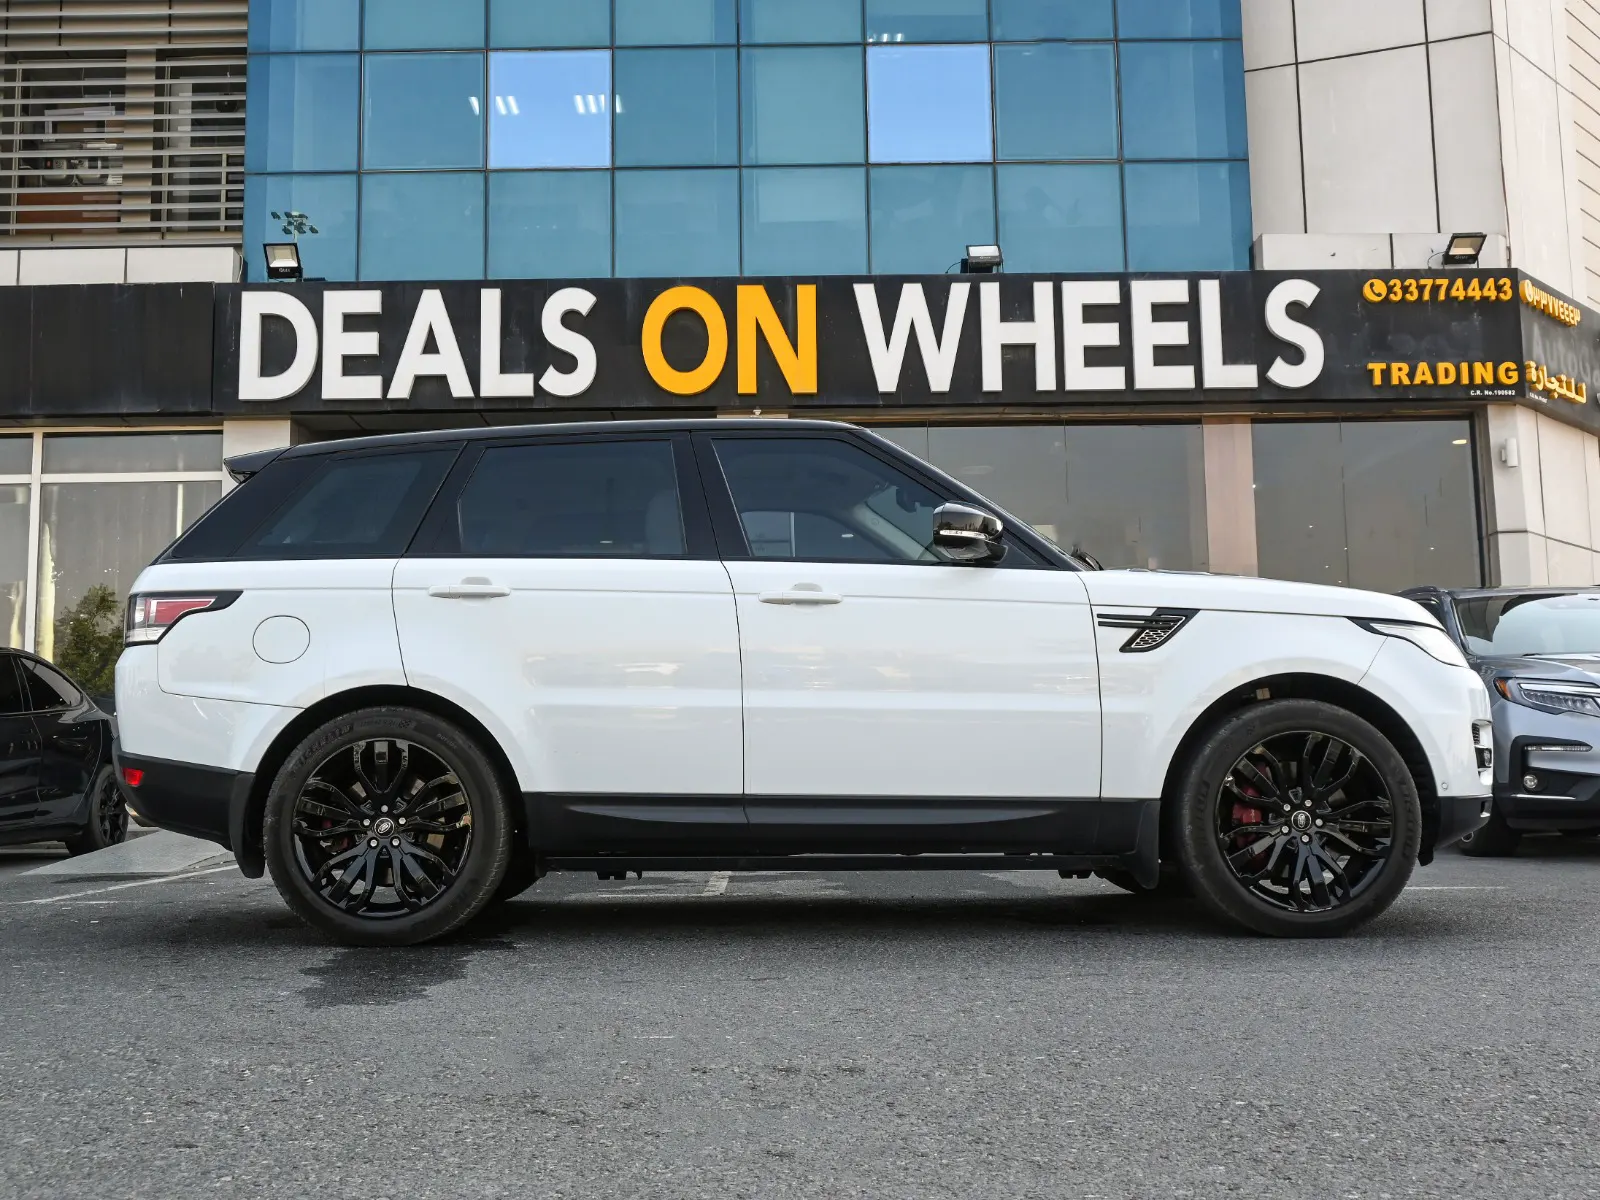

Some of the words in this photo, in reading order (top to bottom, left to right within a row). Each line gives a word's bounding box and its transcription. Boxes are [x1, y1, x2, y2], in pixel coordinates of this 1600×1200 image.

[1388, 277, 1513, 303] 33774443
[237, 287, 597, 400] DEALS
[641, 284, 819, 396] ON
[852, 278, 1326, 394] WHEELS
[1366, 361, 1520, 387] TRADING
